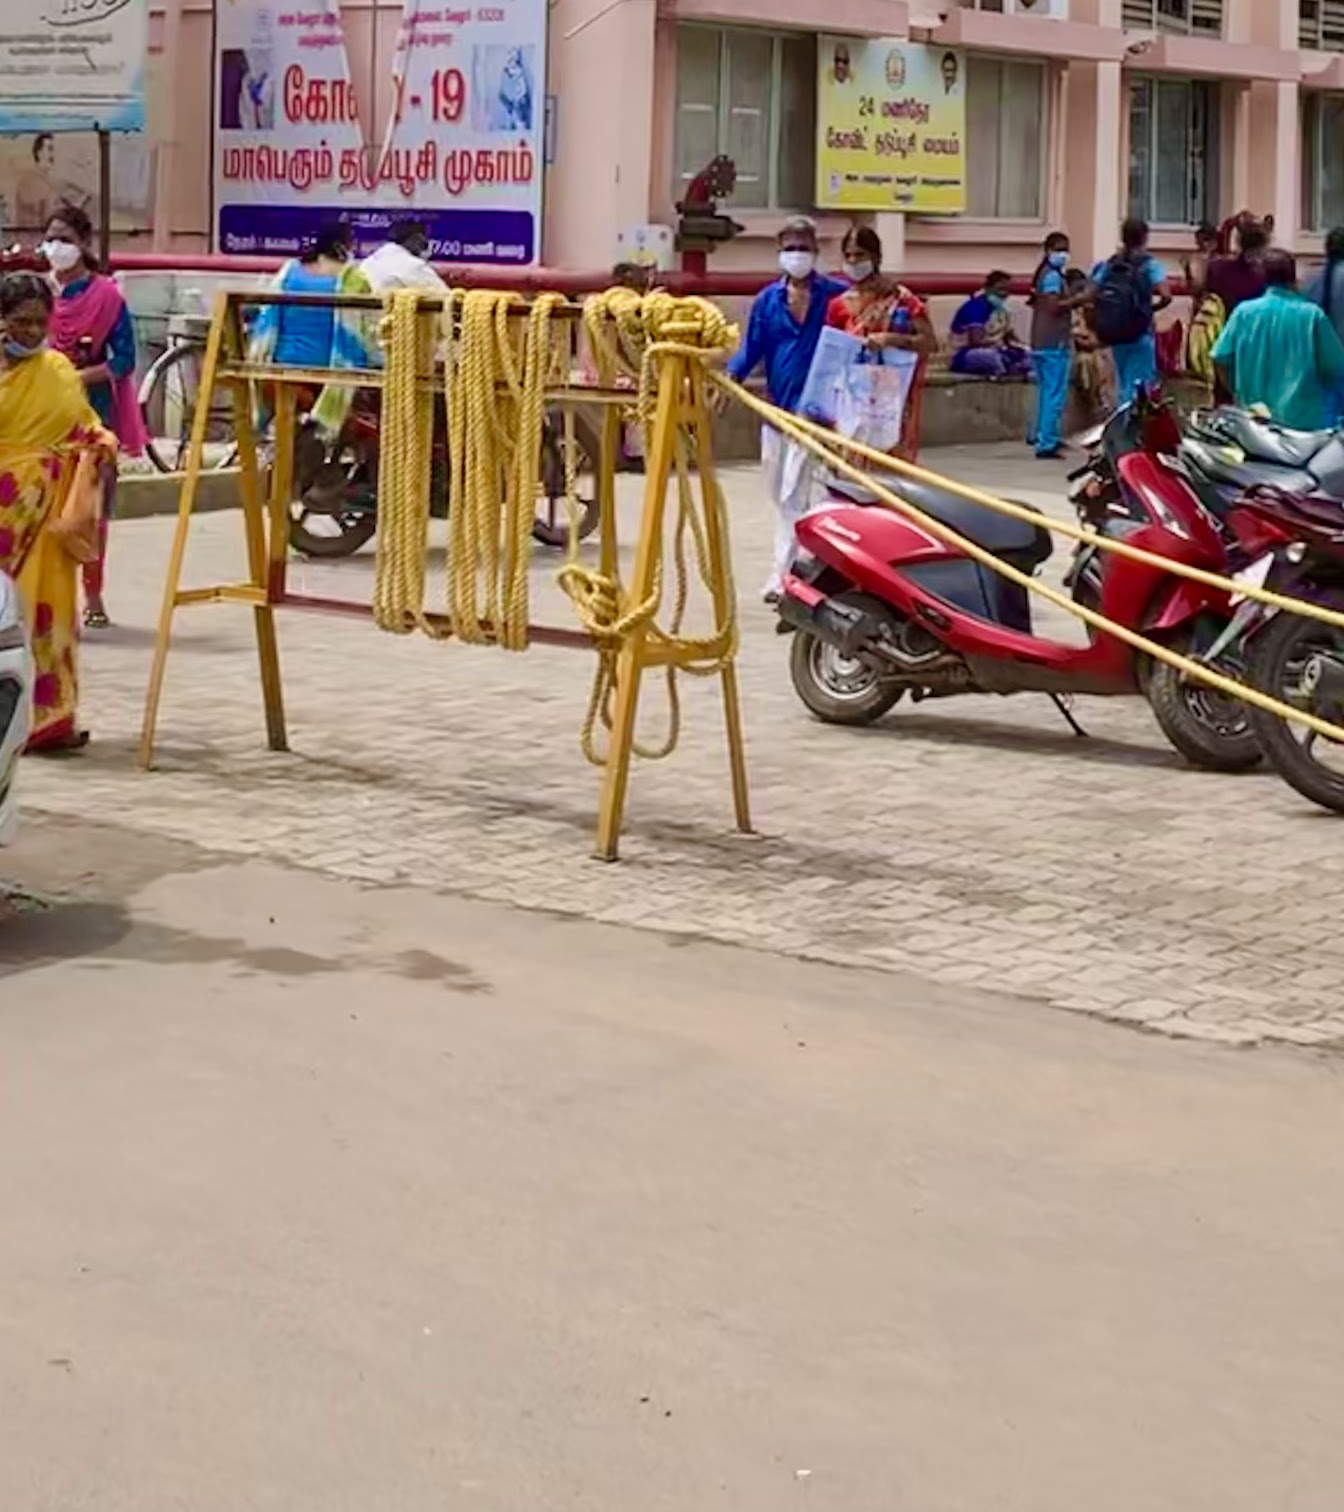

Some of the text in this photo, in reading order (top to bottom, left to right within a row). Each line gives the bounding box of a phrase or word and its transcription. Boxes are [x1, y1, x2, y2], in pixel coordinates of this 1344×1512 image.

[431, 67, 466, 123] 19
[858, 95, 875, 117] 24
[222, 139, 334, 190] மாபெரும்
[444, 139, 533, 194] முகாம்
